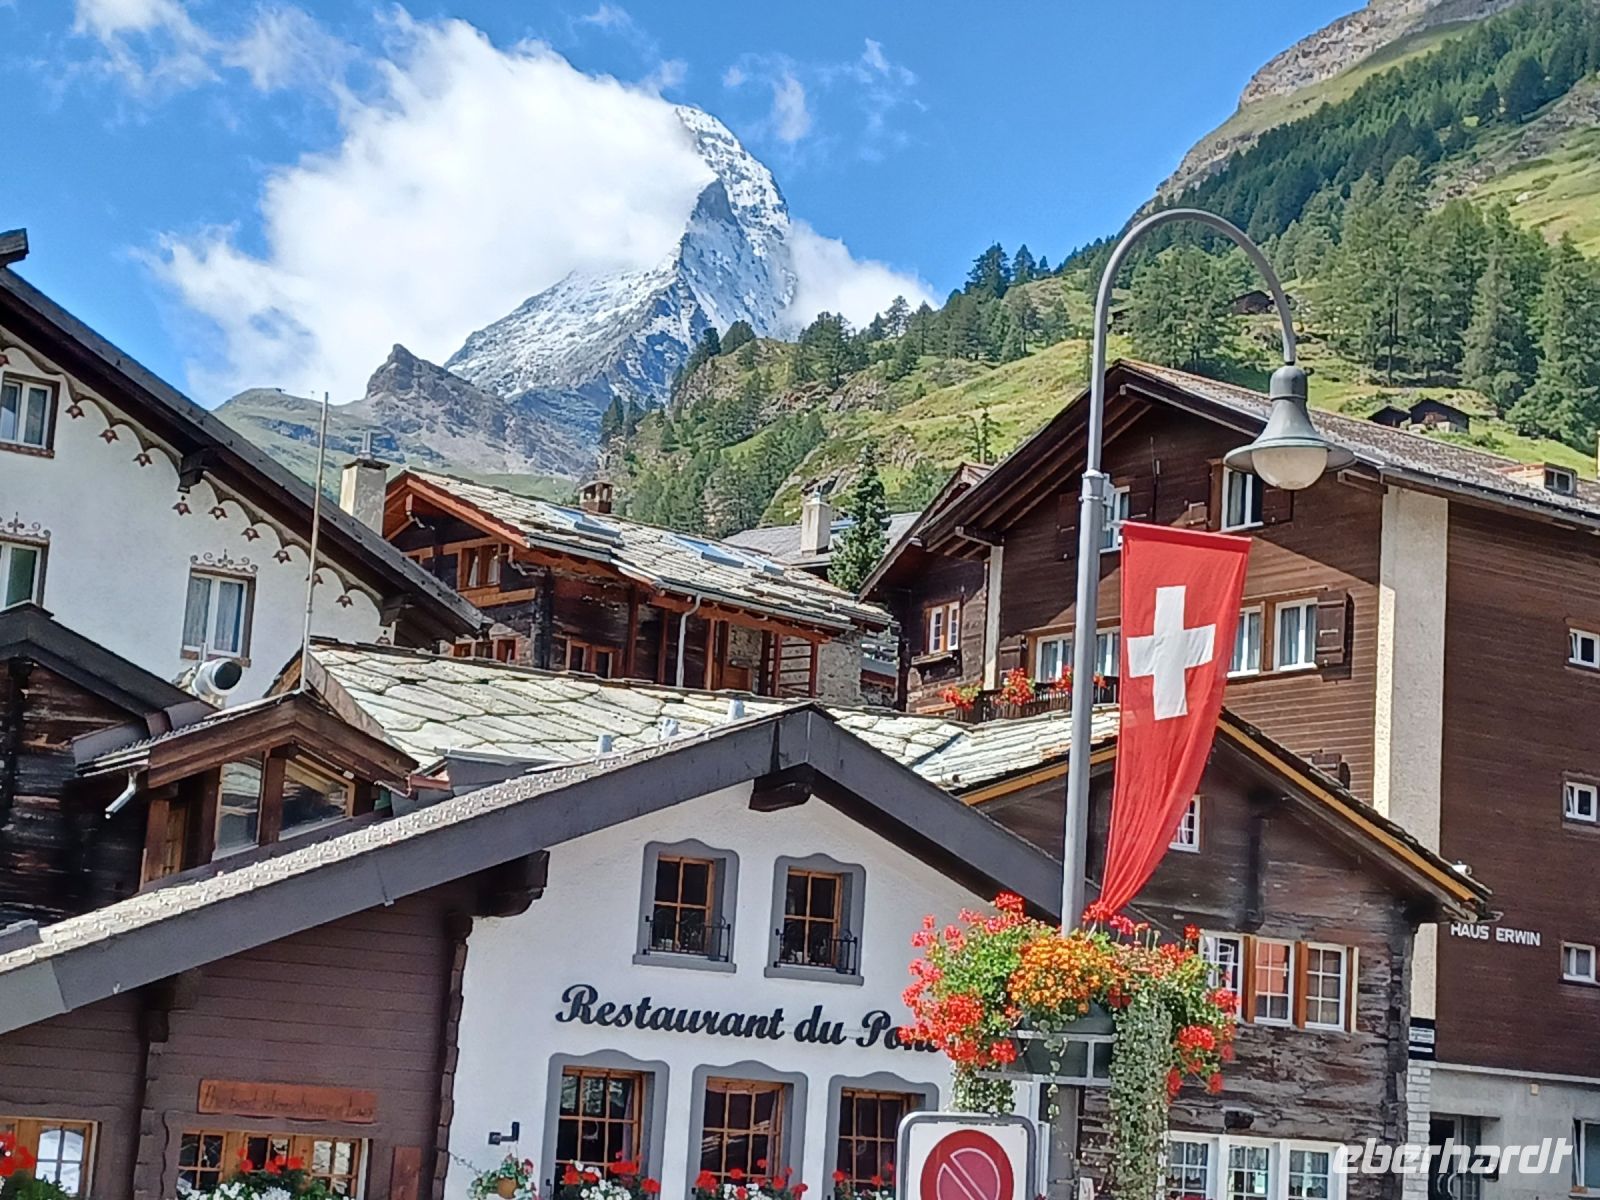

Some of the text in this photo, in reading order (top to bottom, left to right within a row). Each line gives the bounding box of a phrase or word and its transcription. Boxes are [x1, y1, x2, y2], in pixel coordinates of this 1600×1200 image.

[1450, 922, 1541, 947] HAUS ERWIN
[555, 983, 942, 1053] Restaurant du Pon
